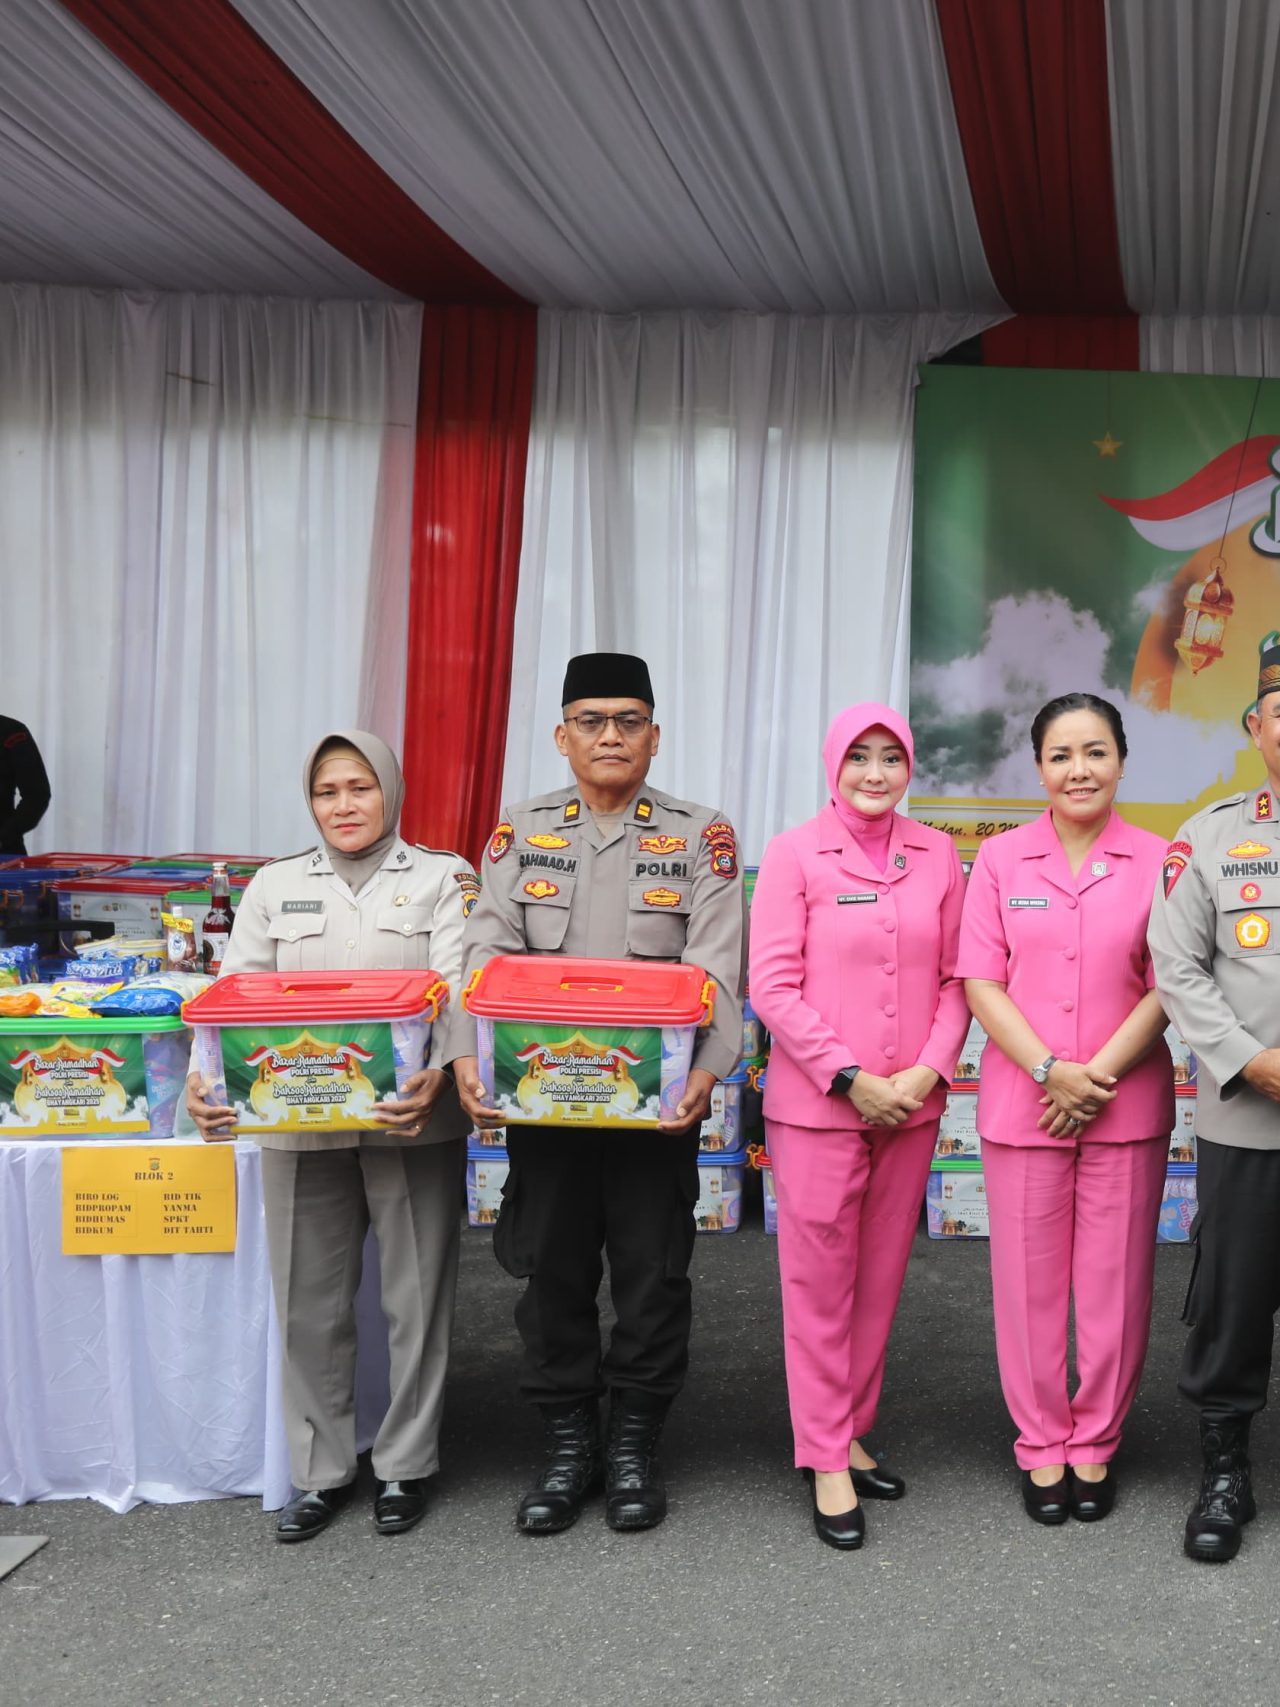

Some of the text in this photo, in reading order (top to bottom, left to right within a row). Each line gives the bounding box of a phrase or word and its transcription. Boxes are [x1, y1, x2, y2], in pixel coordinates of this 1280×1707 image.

[706, 824, 732, 837] POLDA
[975, 822, 995, 836] 20
[635, 862, 687, 878] POLRI
[1221, 861, 1279, 878] WHISNU
[566, 1053, 615, 1067] Ramadhan
[571, 1080, 617, 1095] Ramadhan
[134, 1172, 174, 1181] BLOK 2
[75, 1193, 119, 1201] BIRO LOG
[75, 1204, 132, 1212] BIDPROPAM
[75, 1215, 126, 1223] BIDHUMAS
[163, 1215, 190, 1223] SPKT
[75, 1226, 114, 1234] BIDKUM
[163, 1226, 181, 1234] DIT
